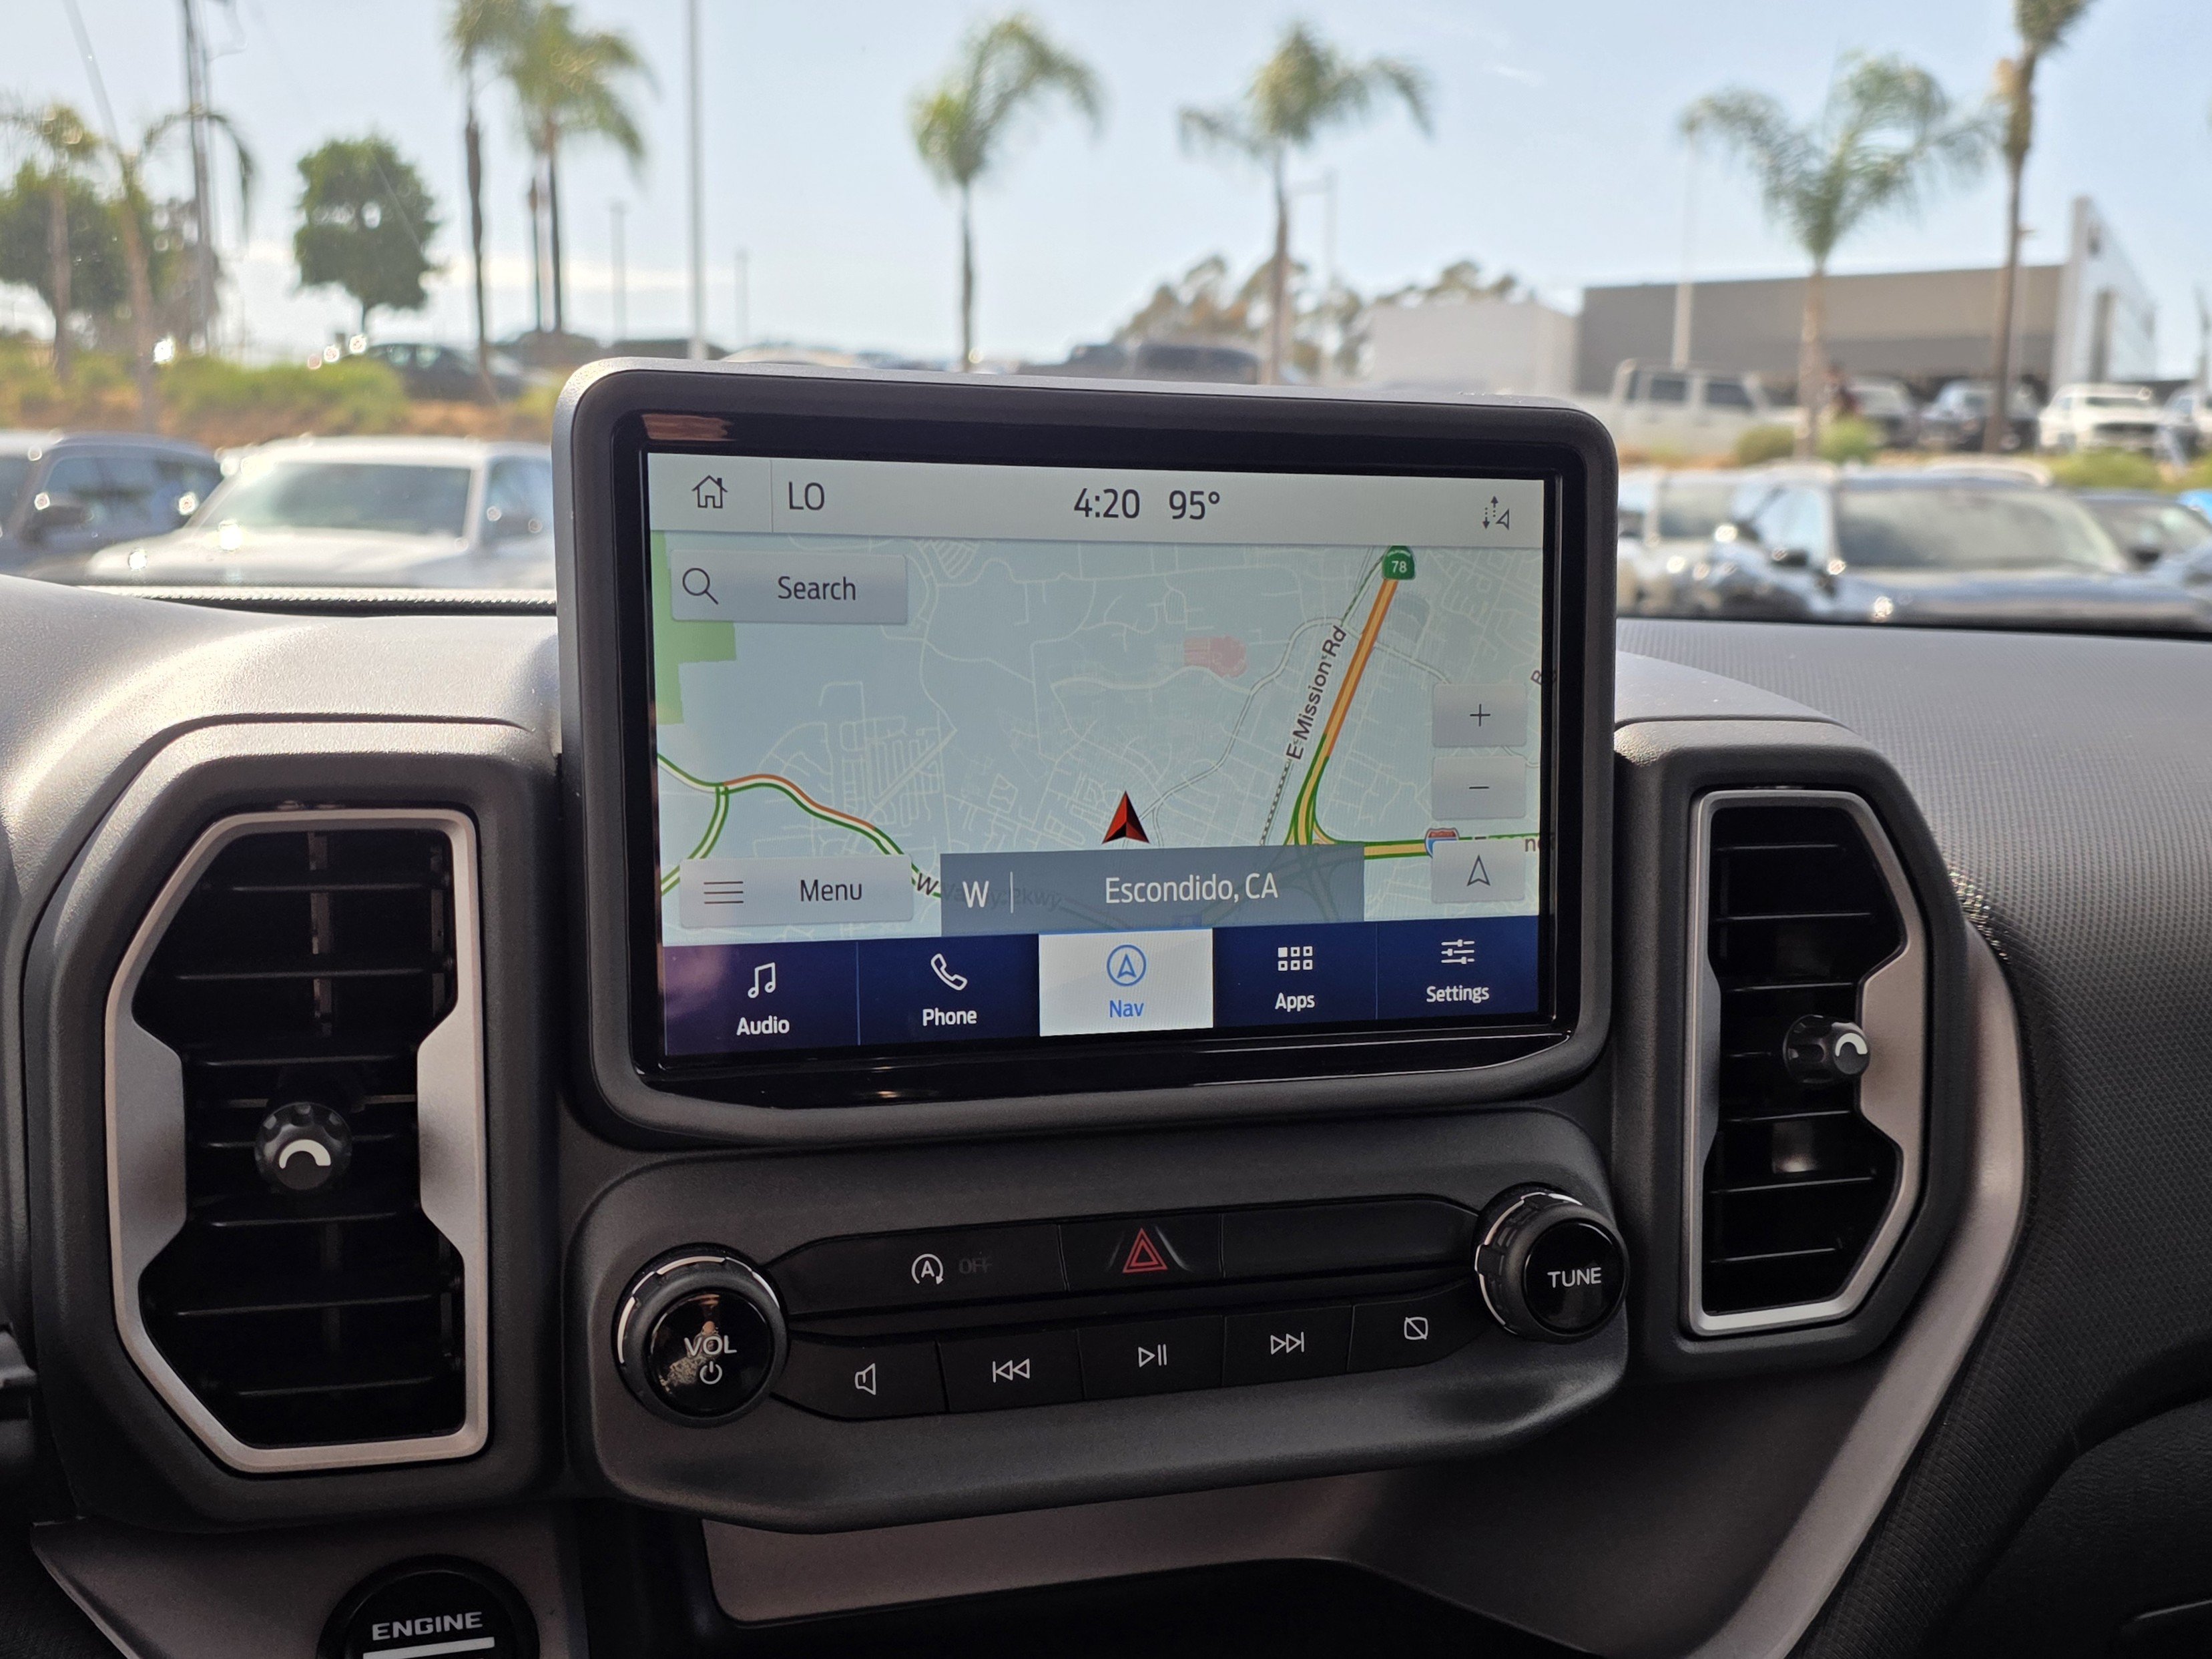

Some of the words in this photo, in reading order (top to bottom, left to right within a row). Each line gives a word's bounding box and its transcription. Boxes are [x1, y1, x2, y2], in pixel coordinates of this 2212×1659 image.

[788, 481, 826, 511] LO
[1073, 487, 1141, 519] 4:20
[1168, 490, 1221, 520] 95°
[1391, 560, 1408, 573] 78
[777, 575, 857, 602] Search
[1322, 625, 1347, 658] Rd
[1292, 661, 1332, 740] Mission
[1286, 742, 1304, 760] E
[800, 879, 863, 903] Menu
[962, 880, 990, 909] W
[1105, 873, 1239, 905] Escondido,
[1245, 871, 1279, 899] CA
[1275, 991, 1316, 1012] Apps
[1425, 984, 1490, 1004] Settings
[922, 1007, 978, 1027] Phone
[1109, 999, 1145, 1019] Nav
[736, 1015, 790, 1036] Audio
[1547, 1266, 1602, 1288] TUNE
[684, 1335, 738, 1356] VOL
[372, 1611, 483, 1641] ENGINE
